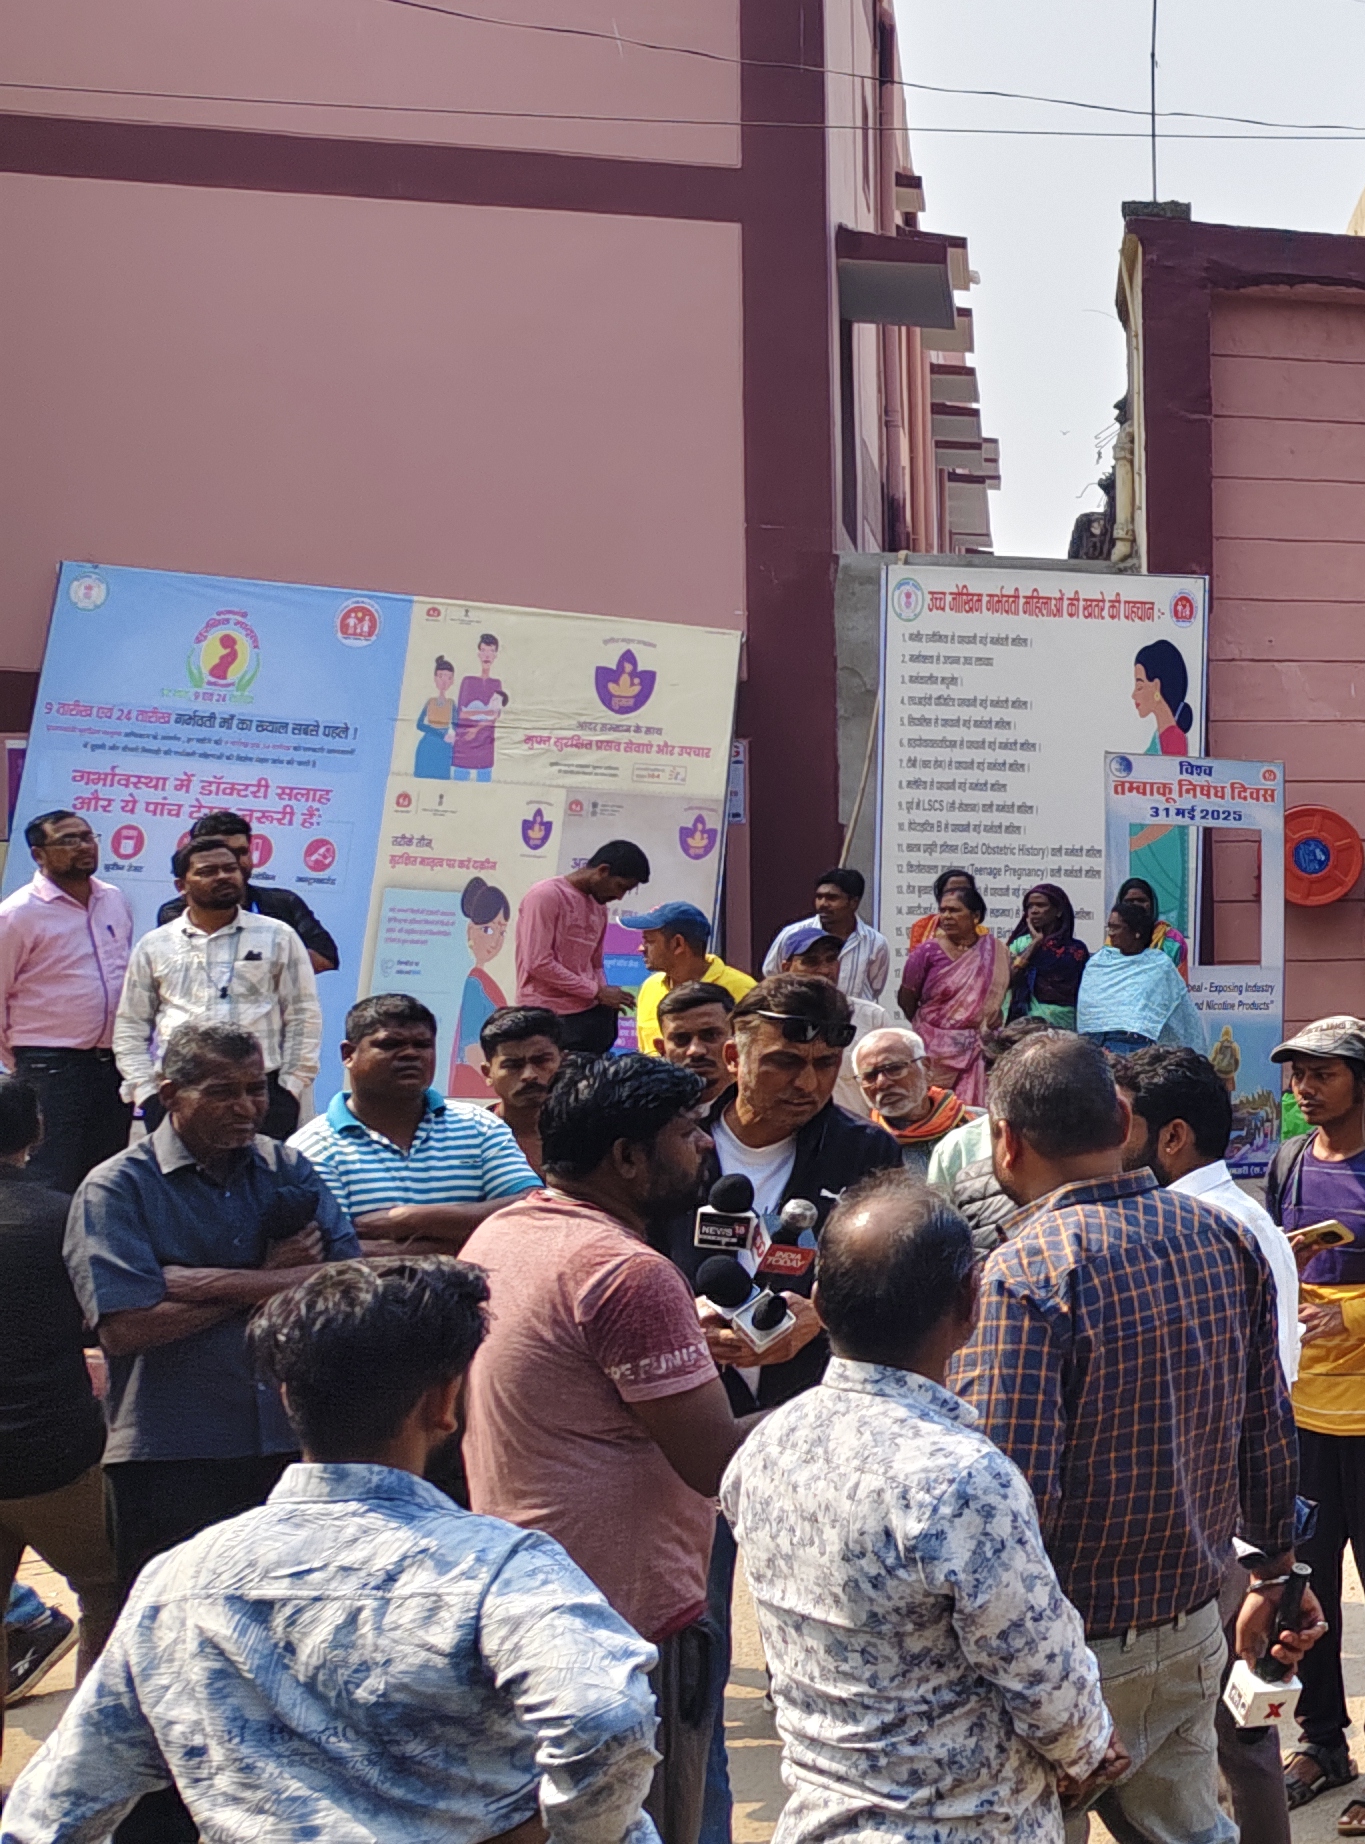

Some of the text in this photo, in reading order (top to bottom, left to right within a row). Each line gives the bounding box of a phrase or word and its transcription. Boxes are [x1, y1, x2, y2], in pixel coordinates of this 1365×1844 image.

[927, 583, 1155, 623] उच्च जोखिम गर्भवती महिलाओं की खतरे की पहचान
[56, 700, 94, 717] तारीख
[115, 708, 132, 721] 24
[136, 707, 172, 724] तारीख
[174, 710, 216, 729] गर्भवती
[236, 718, 252, 732] का
[255, 720, 289, 735] ख्याल
[291, 719, 320, 738] सबसे
[322, 722, 350, 740] पहले
[576, 720, 664, 737] आदर सम्मान के साथ
[553, 734, 593, 753] सुरक्षित
[595, 739, 621, 752] प्रसव
[655, 740, 675, 757] और
[678, 747, 713, 759] उपचार
[1179, 760, 1213, 778] विश्व
[71, 765, 333, 805] गर्भावस्था में डॉक्टरी सलाह
[1112, 778, 1277, 804] तम्बाकू निषेध दिवस
[72, 790, 113, 813] और
[120, 793, 139, 814] ये
[144, 797, 184, 818] पांच
[922, 799, 944, 812] LSCS
[1150, 804, 1242, 821] 31 मई 2025
[392, 833, 415, 848] तरीके
[960, 843, 980, 856] (Bad
[980, 843, 1016, 857] Obstetric
[1017, 845, 1049, 861] History)
[389, 852, 418, 869] सुरक्षित
[445, 858, 457, 870] पर
[457, 856, 472, 871] करें
[967, 863, 1049, 880] (Teenage Pregnancy)
[1209, 981, 1243, 996] Exposing
[1245, 981, 1276, 996] Industry
[1194, 999, 1204, 1011] nd
[1205, 999, 1236, 1011] Nicotine
[702, 1224, 748, 1237] NEWS 18
[766, 1256, 807, 1269] TODAY
[774, 1250, 803, 1259] INDIA
